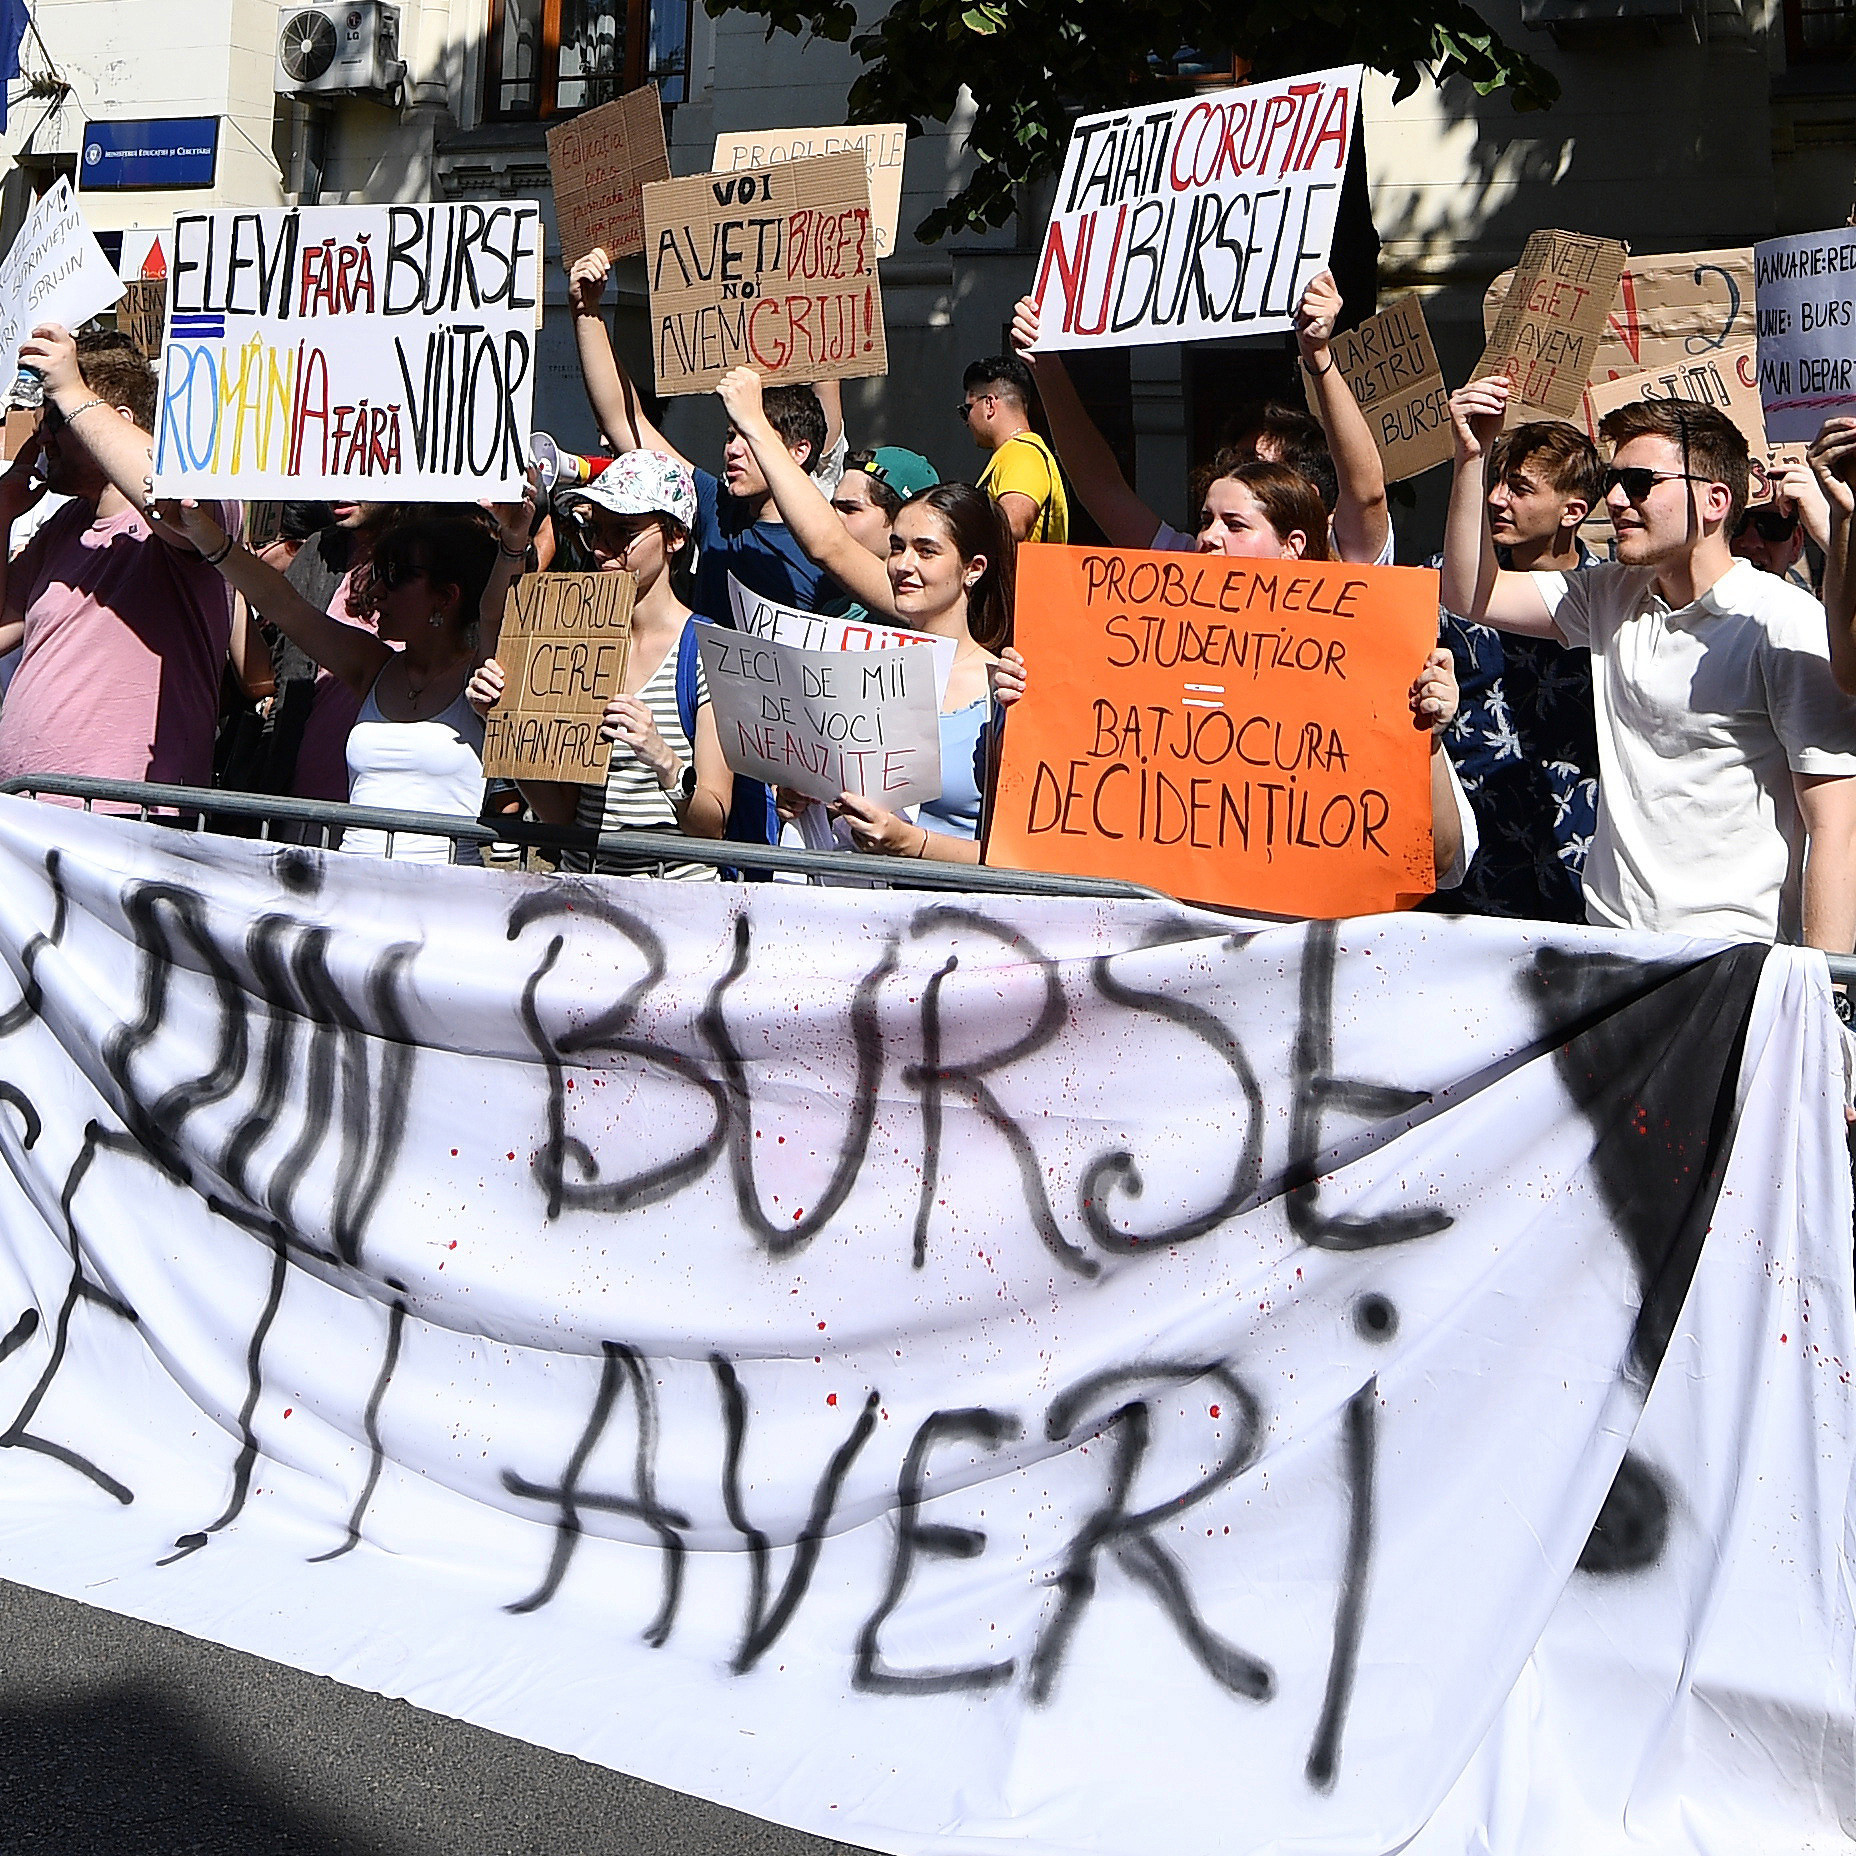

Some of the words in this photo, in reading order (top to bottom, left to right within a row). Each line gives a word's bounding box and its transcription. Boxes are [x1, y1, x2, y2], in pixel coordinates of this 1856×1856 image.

[347, 32, 359, 40] LG
[712, 174, 772, 207] VOI
[172, 206, 302, 319] ELEVI
[383, 206, 538, 317] BURSE
[721, 274, 762, 299] NOI
[1035, 204, 1127, 335] NU
[1111, 183, 1338, 333] BURSELE
[660, 300, 751, 379] AVEM
[749, 284, 874, 370] GRIJI!
[1336, 309, 1422, 377] LARIUL
[1515, 322, 1584, 369] AVEM
[157, 330, 329, 476] ROMÂNIA
[395, 323, 530, 481] VIITOR
[1758, 357, 1790, 396] MAI
[1382, 386, 1451, 446] BURSE
[511, 575, 625, 631] VIITORUL
[1082, 556, 1368, 618] PROBLEMELE
[530, 643, 616, 701] CERE
[708, 639, 782, 687] ZECI
[802, 665, 837, 699] DE
[862, 657, 906, 702] MII
[1106, 614, 1347, 680] STUDENȚILOR
[760, 695, 796, 725] DE
[804, 706, 884, 746] VOCI
[1087, 698, 1349, 773] BATJOCURA
[737, 720, 916, 797] NEAUZITE
[1028, 756, 1391, 864] DECIDENȚILOR
[505, 874, 1452, 1277] BURSE
[505, 1288, 1401, 1794] AVERI
